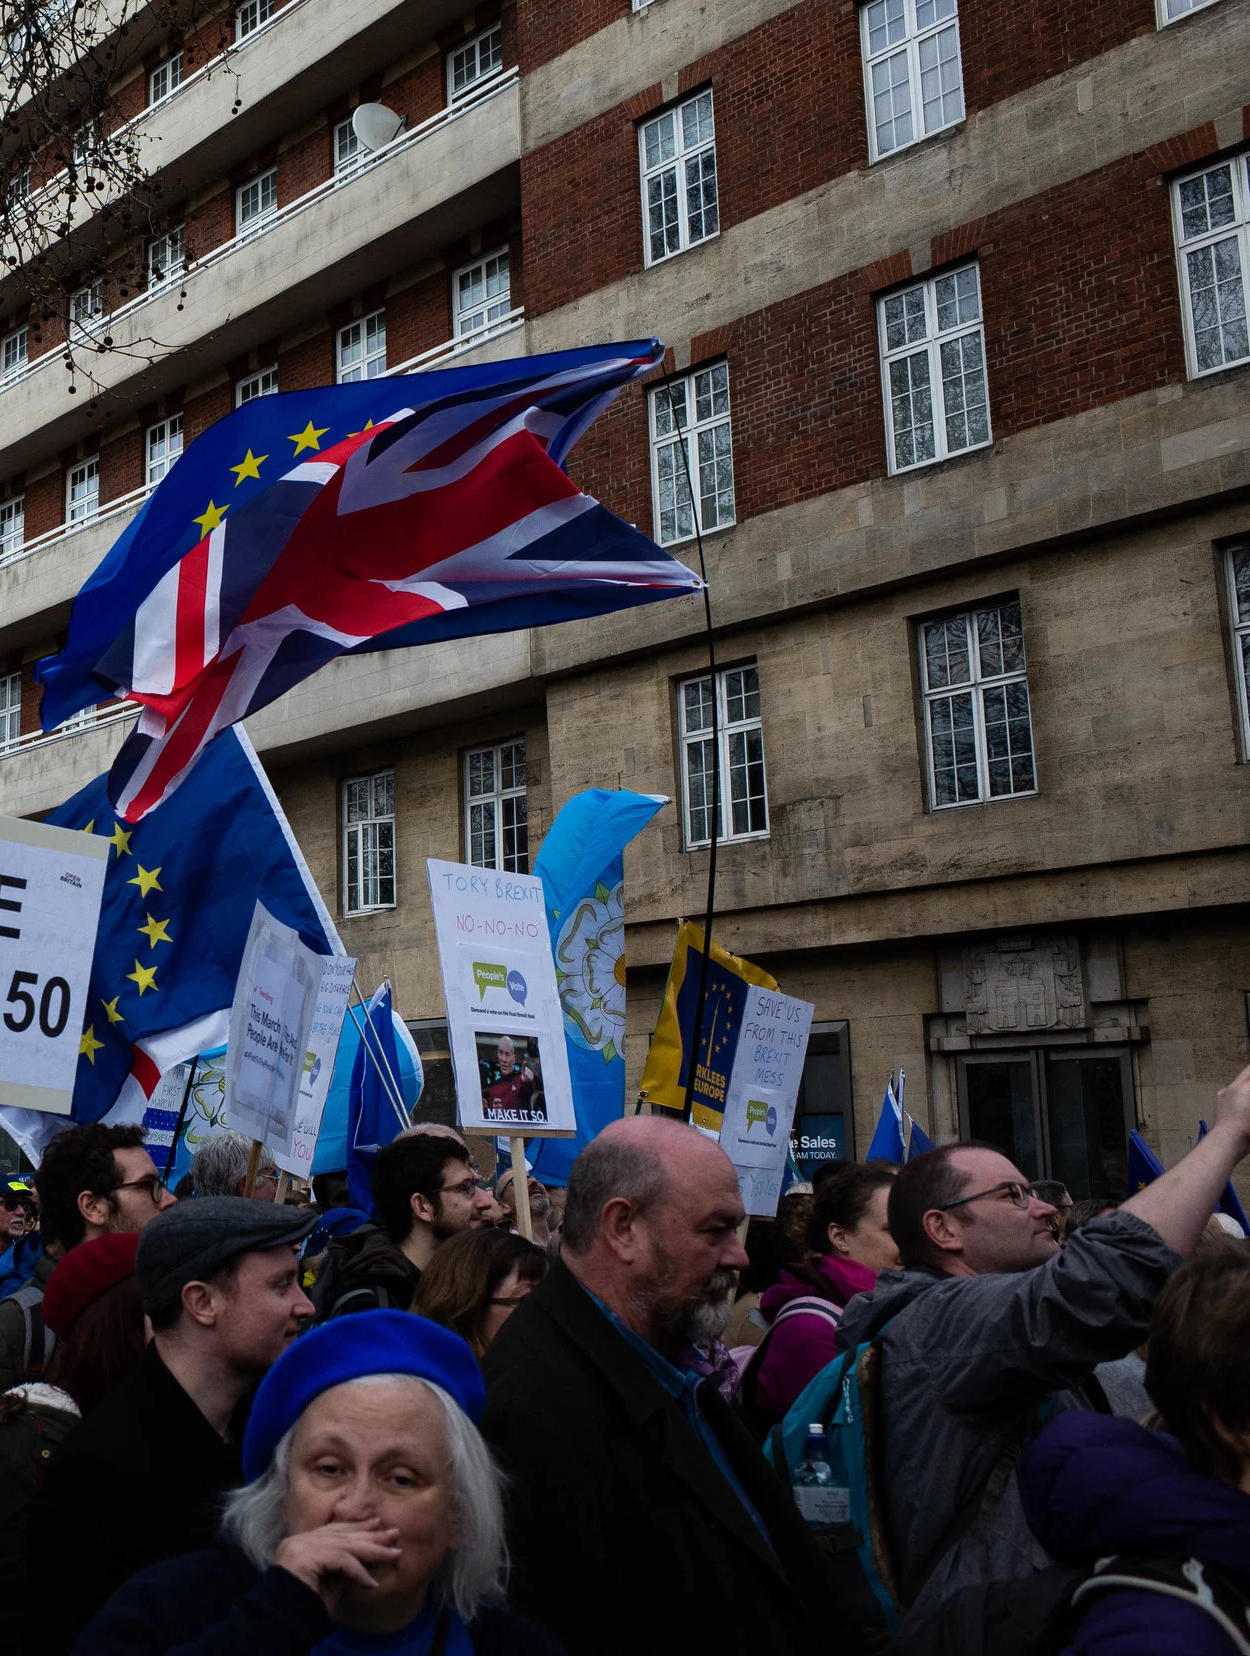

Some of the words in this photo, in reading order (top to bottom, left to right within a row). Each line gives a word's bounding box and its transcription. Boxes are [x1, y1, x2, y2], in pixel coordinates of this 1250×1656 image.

[442, 873, 489, 896] TORY
[495, 878, 542, 903] BREXIT
[476, 968, 504, 982] People's
[509, 981, 525, 992] Vote
[3, 970, 71, 1038] 50
[756, 997, 784, 1019] SAVE
[787, 1006, 801, 1022] US
[251, 1003, 261, 1023] This
[261, 1010, 281, 1034] March
[246, 1022, 267, 1047] People
[267, 1035, 279, 1052] Are
[744, 1022, 775, 1042] FROM
[780, 1031, 803, 1048] THIS
[754, 1044, 791, 1066] BREXIT
[696, 1063, 726, 1088] RKLEES
[754, 1068, 784, 1087] MESS
[693, 1077, 725, 1102] EUROPE
[487, 1108, 517, 1121] MAKE
[519, 1109, 529, 1121] IT
[531, 1110, 547, 1122] SO.
[293, 1137, 313, 1160] YOU
[801, 1136, 836, 1148] Sales
[810, 1151, 837, 1159] TODAY.
